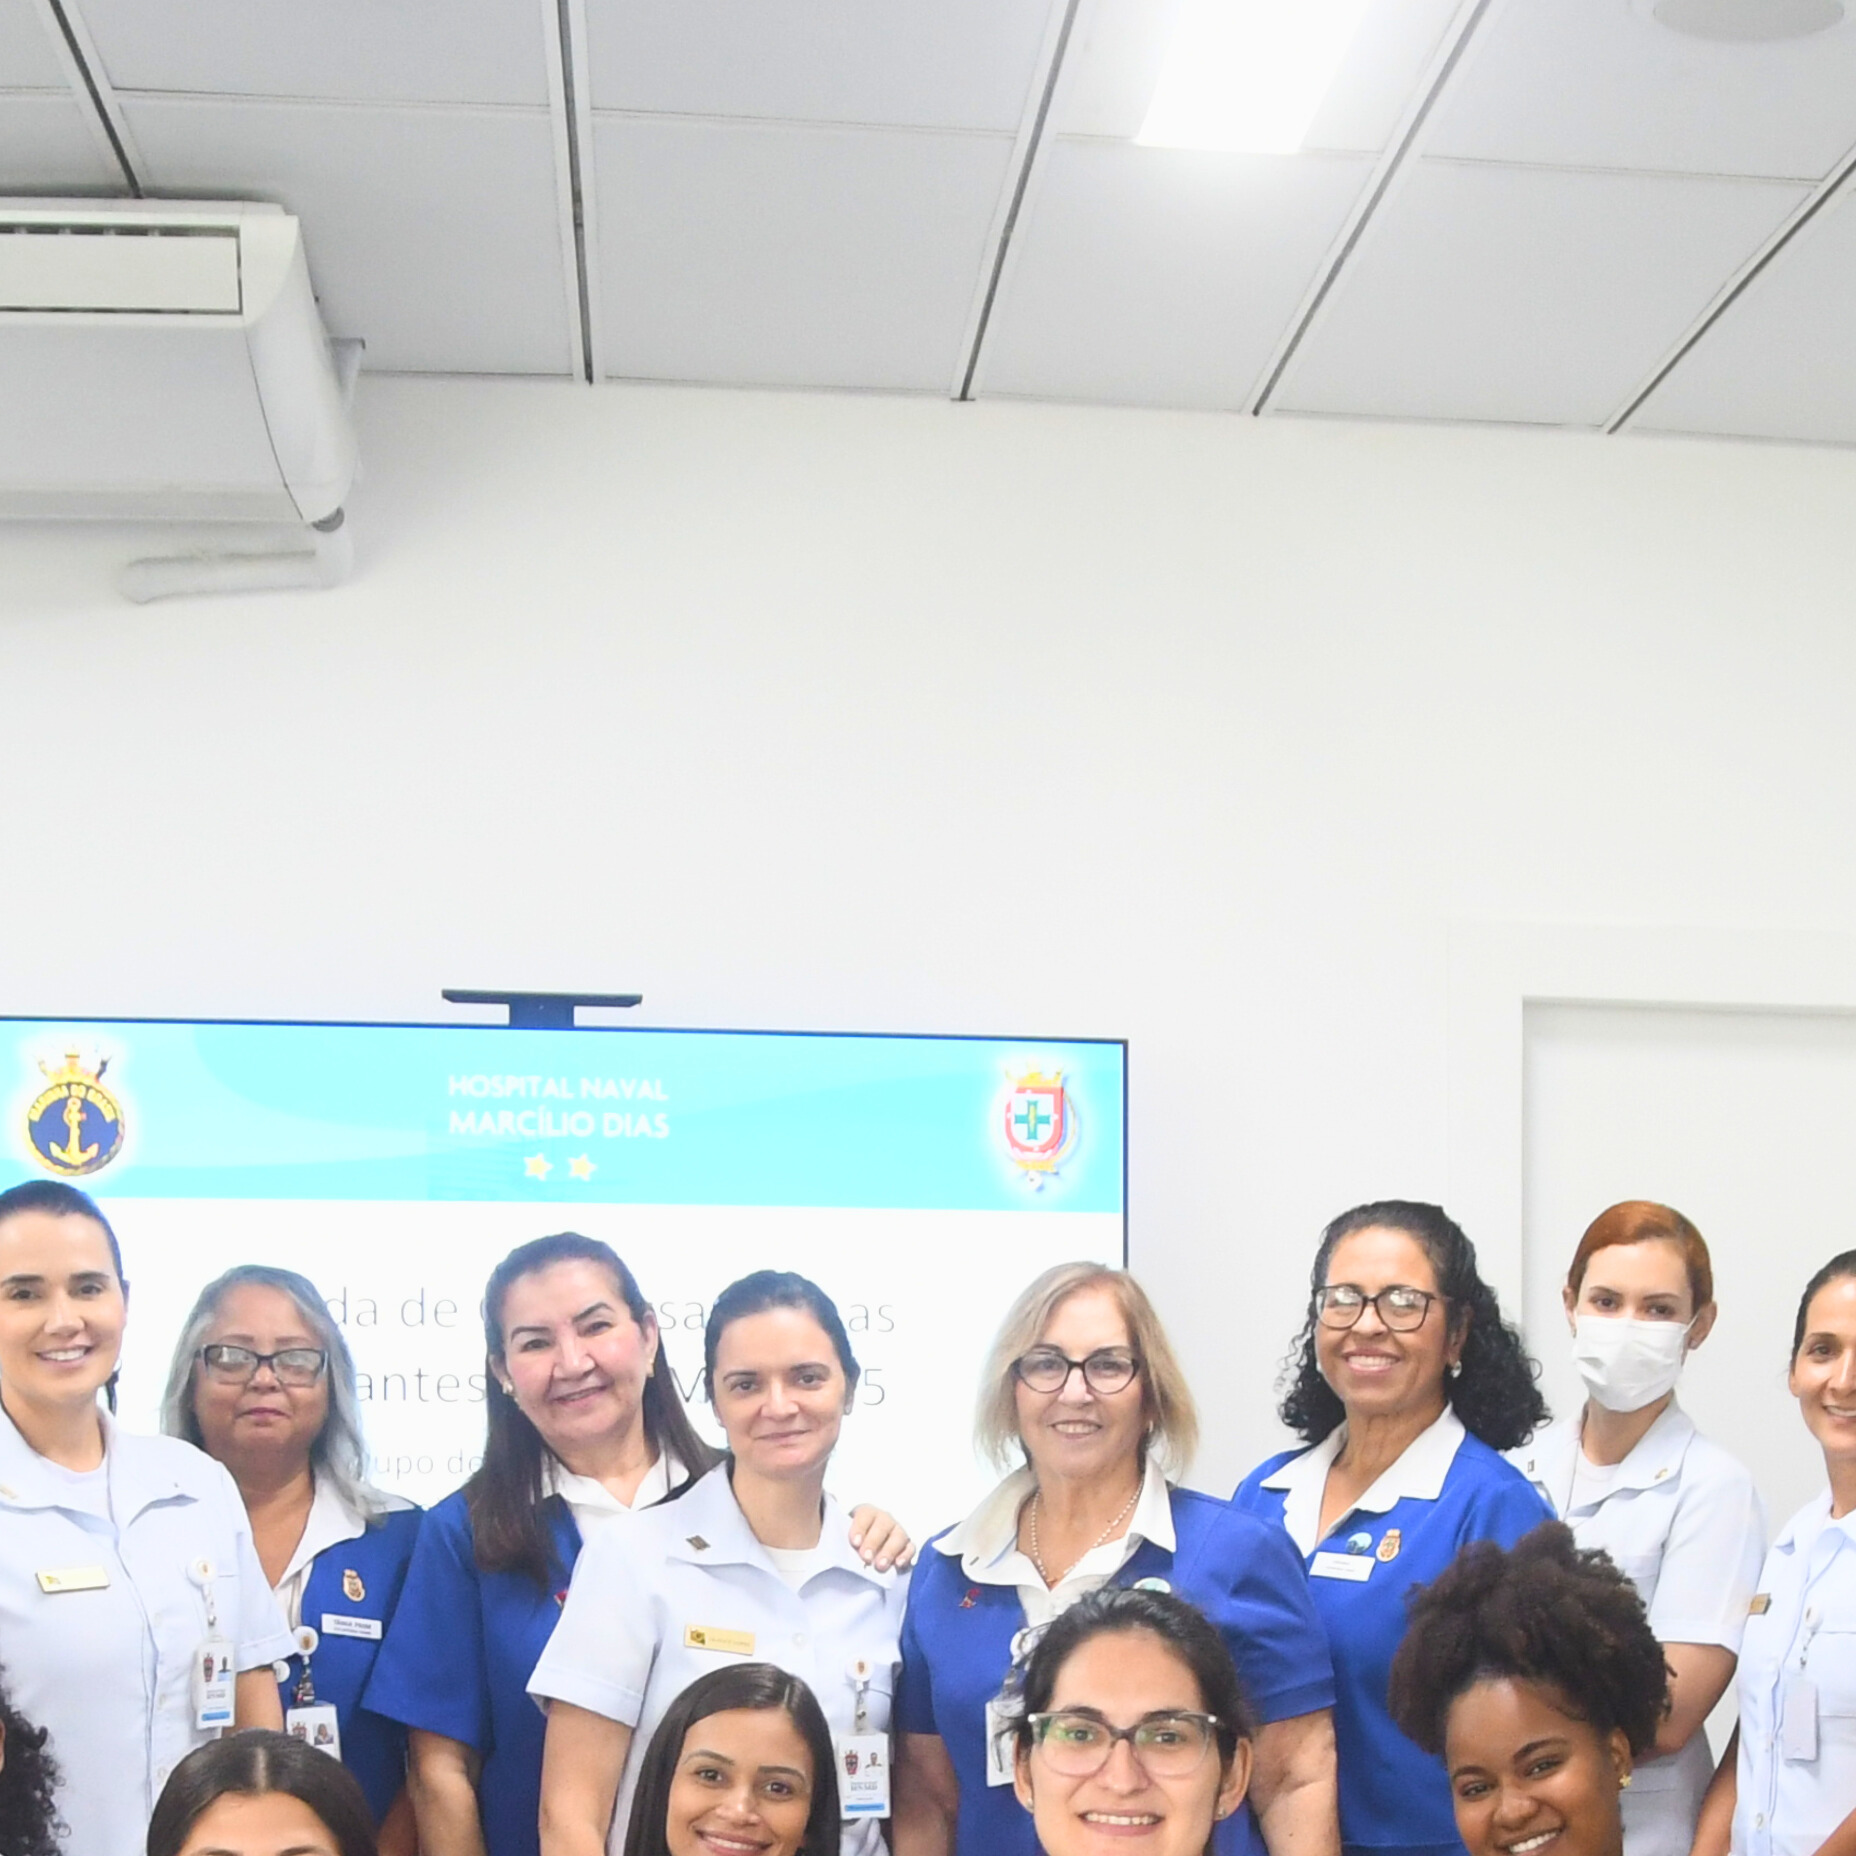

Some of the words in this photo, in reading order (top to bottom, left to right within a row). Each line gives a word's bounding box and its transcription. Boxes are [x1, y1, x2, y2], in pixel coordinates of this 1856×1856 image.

[448, 1074, 575, 1100] HOSPITAL
[580, 1076, 670, 1102] NAVAL
[448, 1103, 596, 1138] MARCÍLIO
[602, 1111, 671, 1140] DIAS
[326, 1285, 378, 1328] da
[400, 1287, 458, 1328] de
[355, 1367, 487, 1402] antes
[375, 1454, 434, 1481] upo
